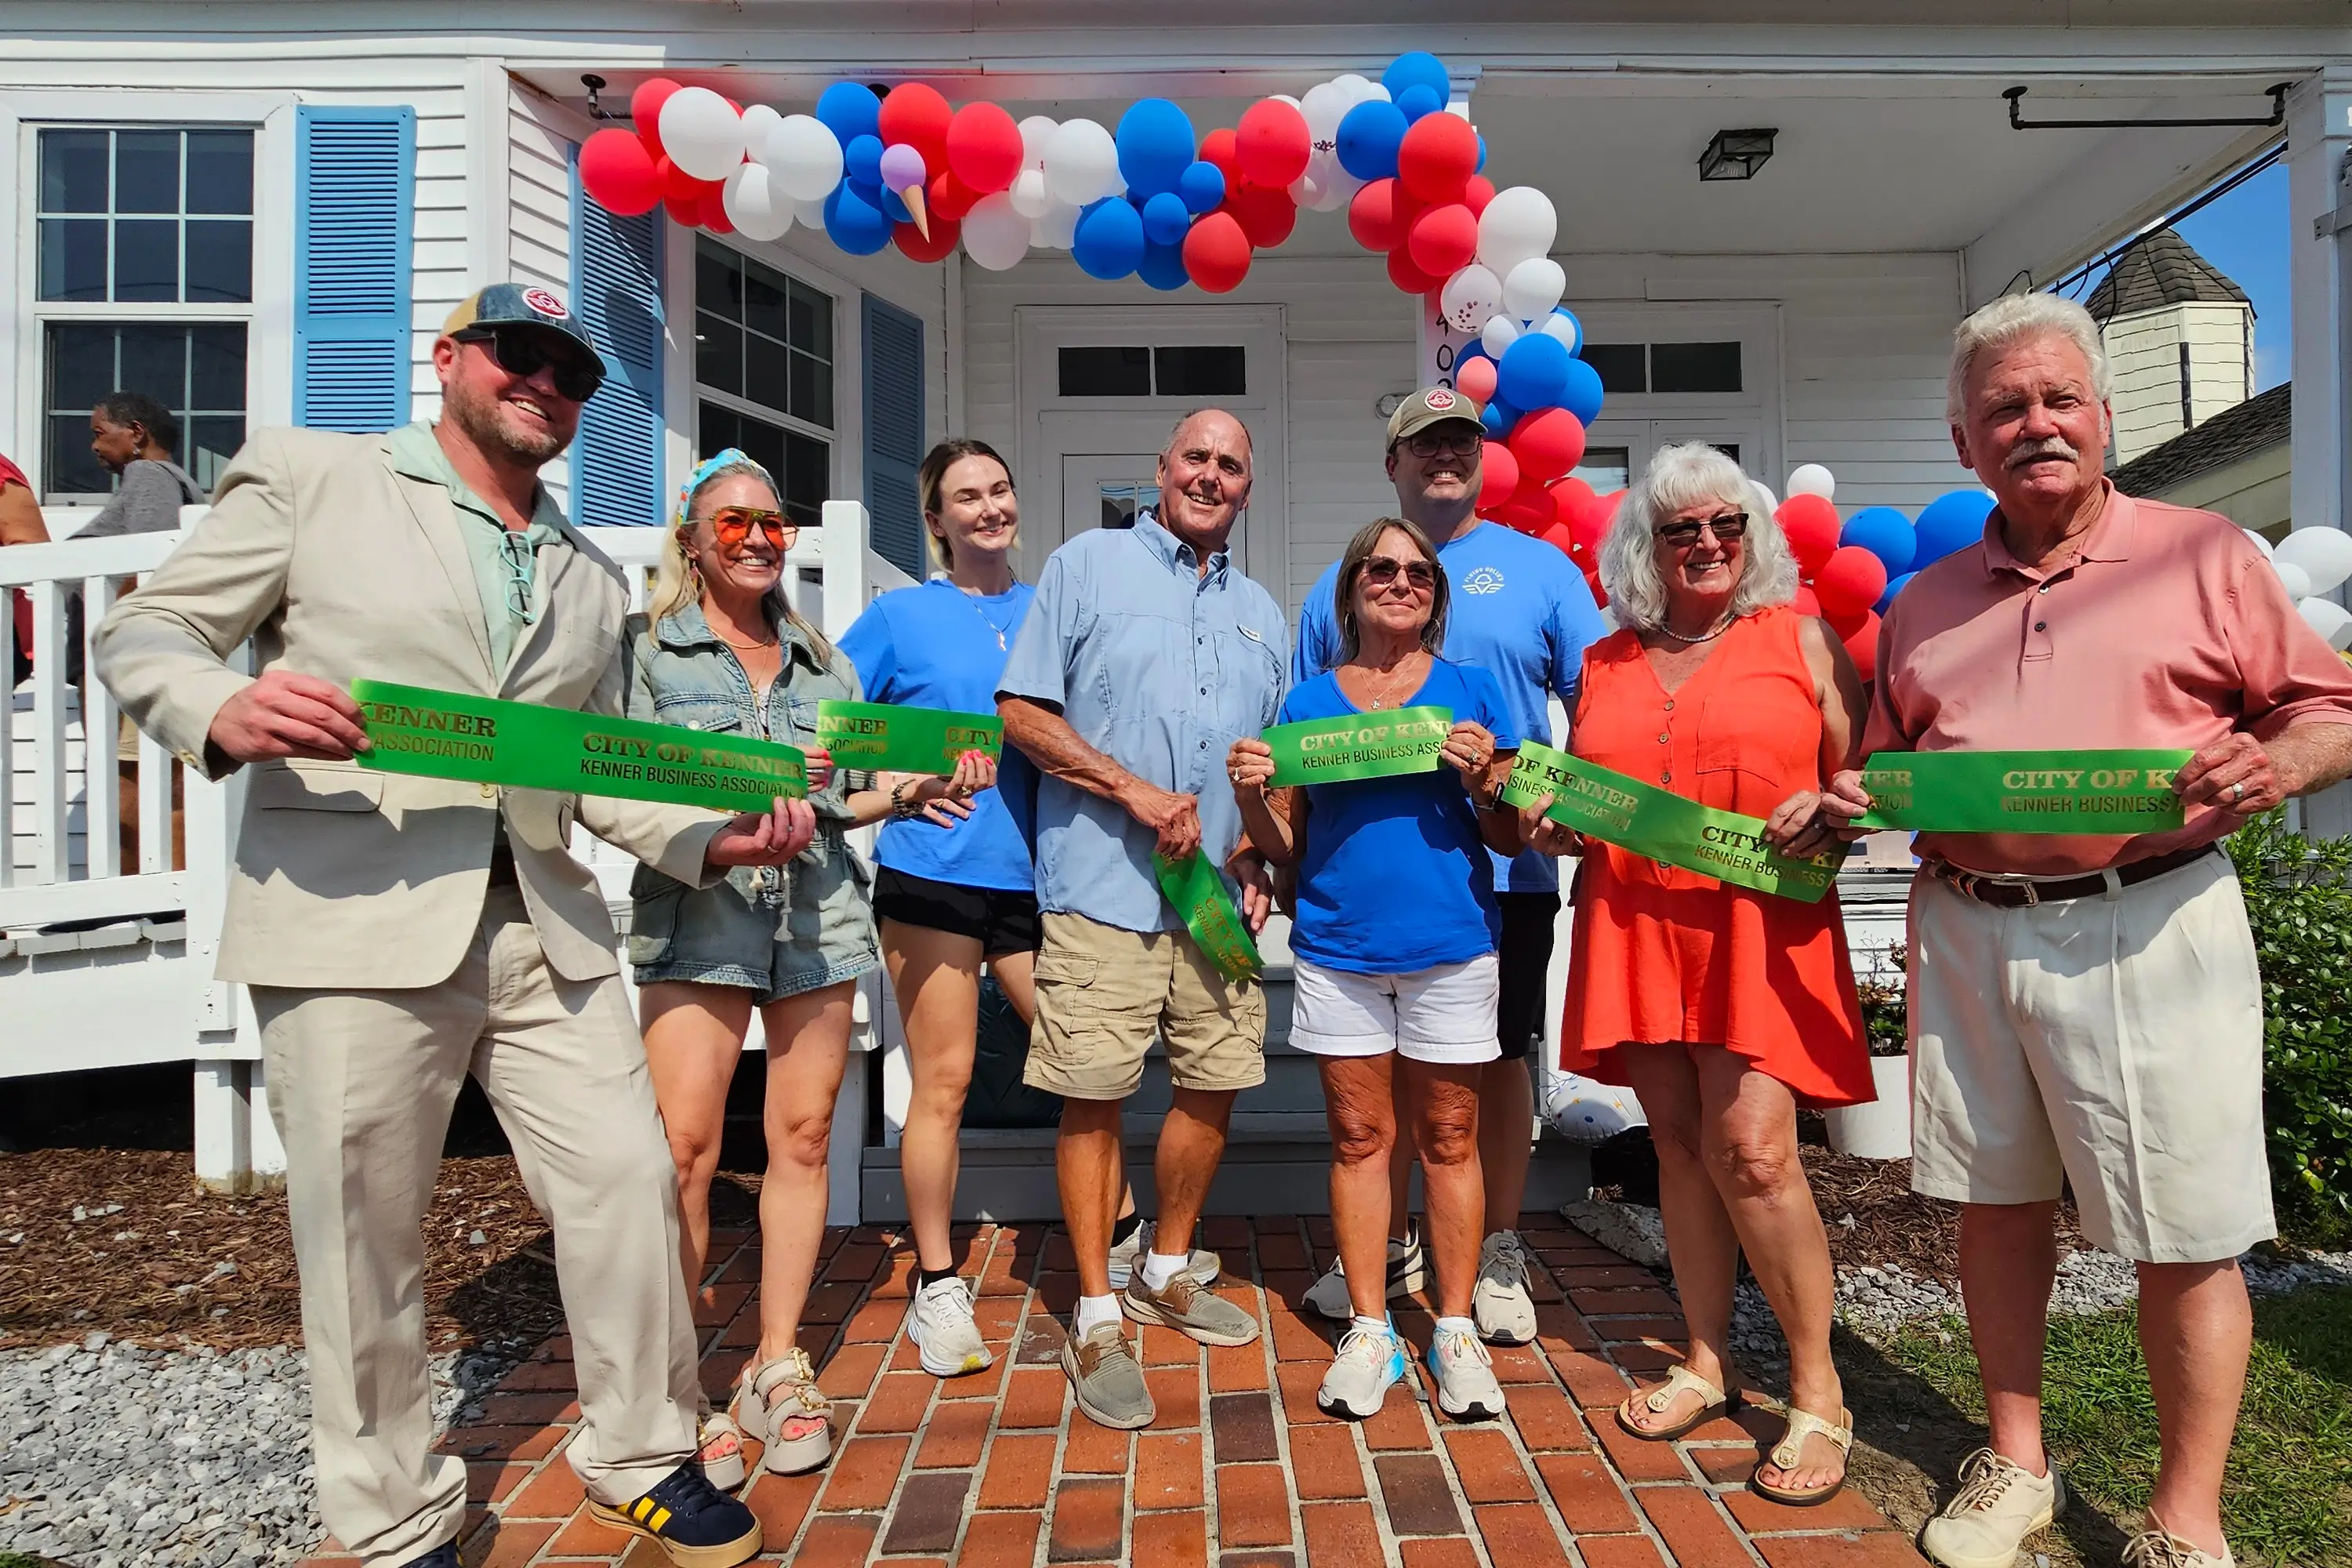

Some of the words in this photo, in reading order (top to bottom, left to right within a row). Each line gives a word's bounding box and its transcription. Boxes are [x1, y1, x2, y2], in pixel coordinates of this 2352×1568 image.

[372, 732, 495, 762] ASSOCIATION
[947, 728, 995, 746] CITY
[1300, 731, 1354, 751] CITY
[1357, 726, 1389, 744] OF
[583, 733, 652, 758] CITY
[657, 744, 694, 764] OF
[699, 748, 804, 781] KENNER
[1301, 752, 1350, 769] KENNER
[1354, 744, 1414, 763] BUSINESS
[580, 758, 642, 780] KENNER
[647, 766, 717, 789] BUSINESS
[2002, 771, 2085, 789] CITY
[2090, 770, 2139, 789] OF
[1542, 765, 1639, 814] KENNER
[2002, 797, 2072, 813] KENNER
[2078, 797, 2170, 813] BUSINESS
[1701, 826, 1765, 854] CITY
[1695, 844, 1751, 870] KENNER
